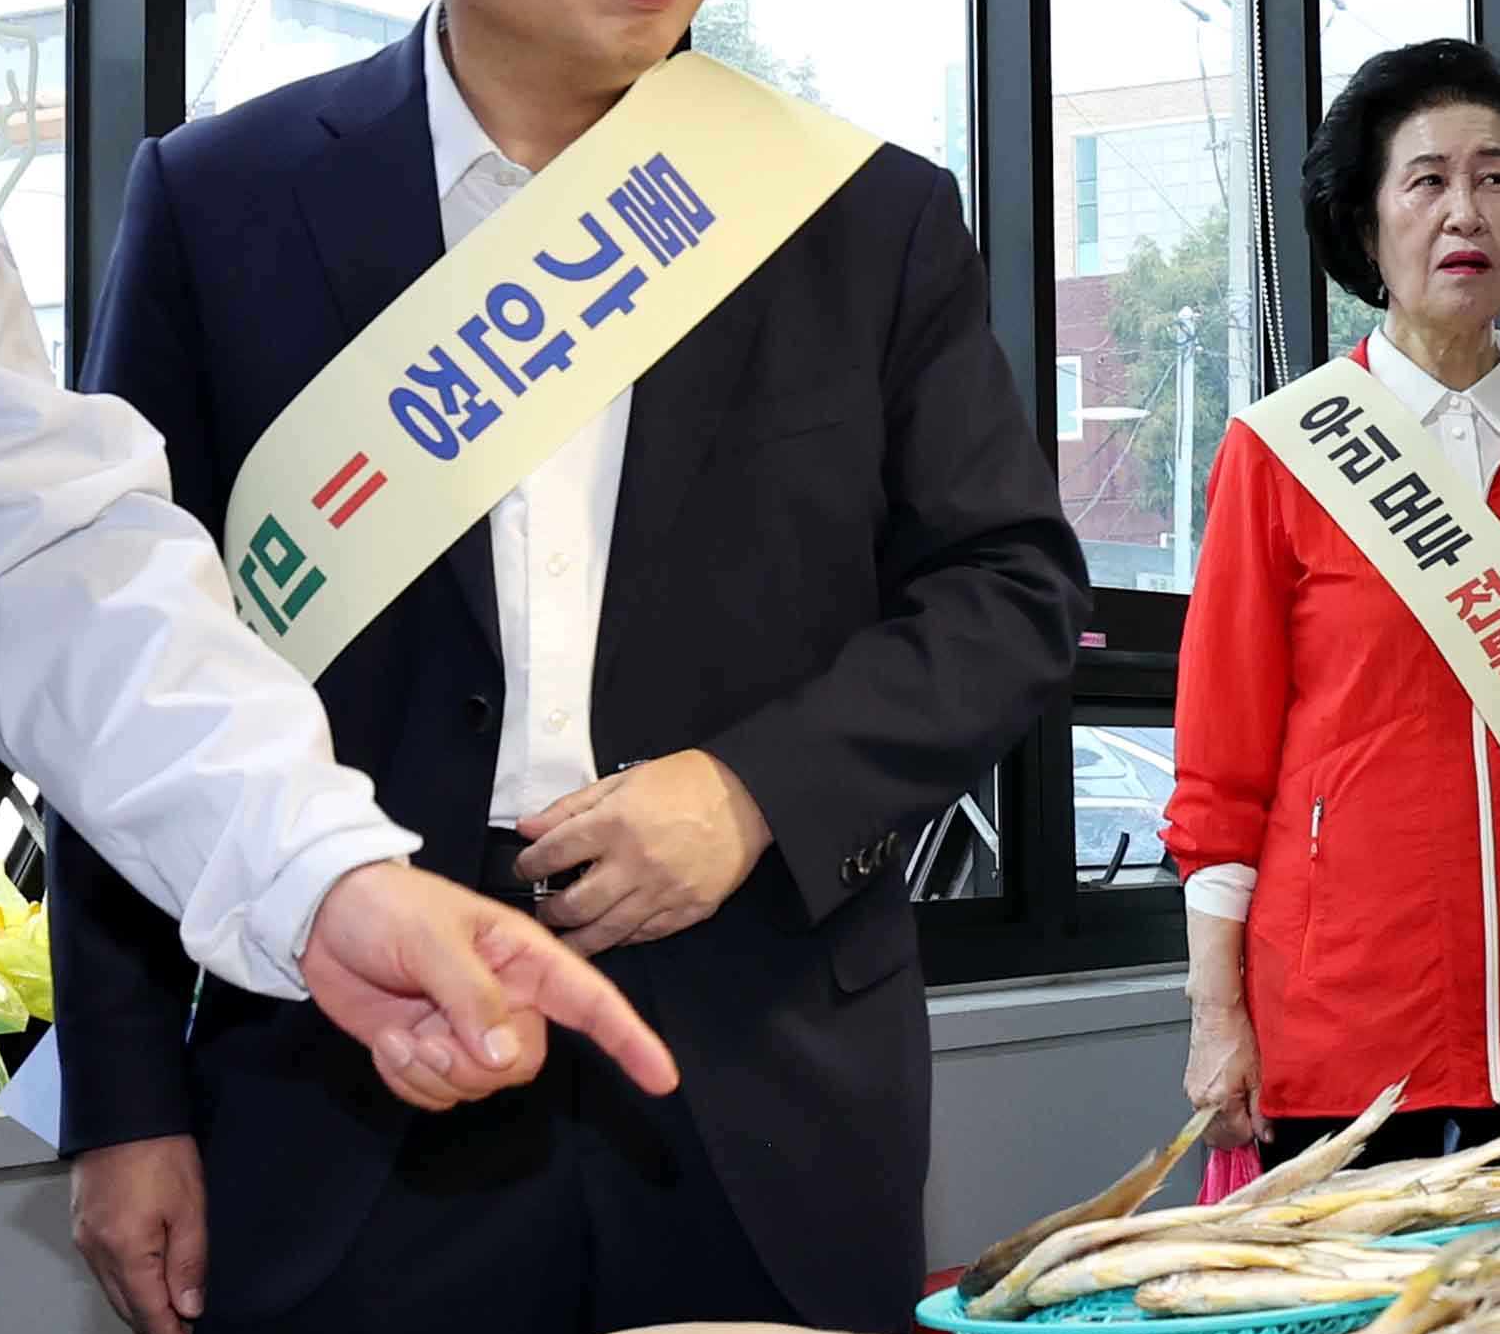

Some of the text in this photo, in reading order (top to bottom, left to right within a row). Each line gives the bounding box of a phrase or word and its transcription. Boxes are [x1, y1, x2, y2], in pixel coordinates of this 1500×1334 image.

[388, 152, 716, 461] 물가안정
[1300, 396, 1402, 485] 우리
[1369, 472, 1473, 571] 모두
[234, 512, 328, 637] 민
